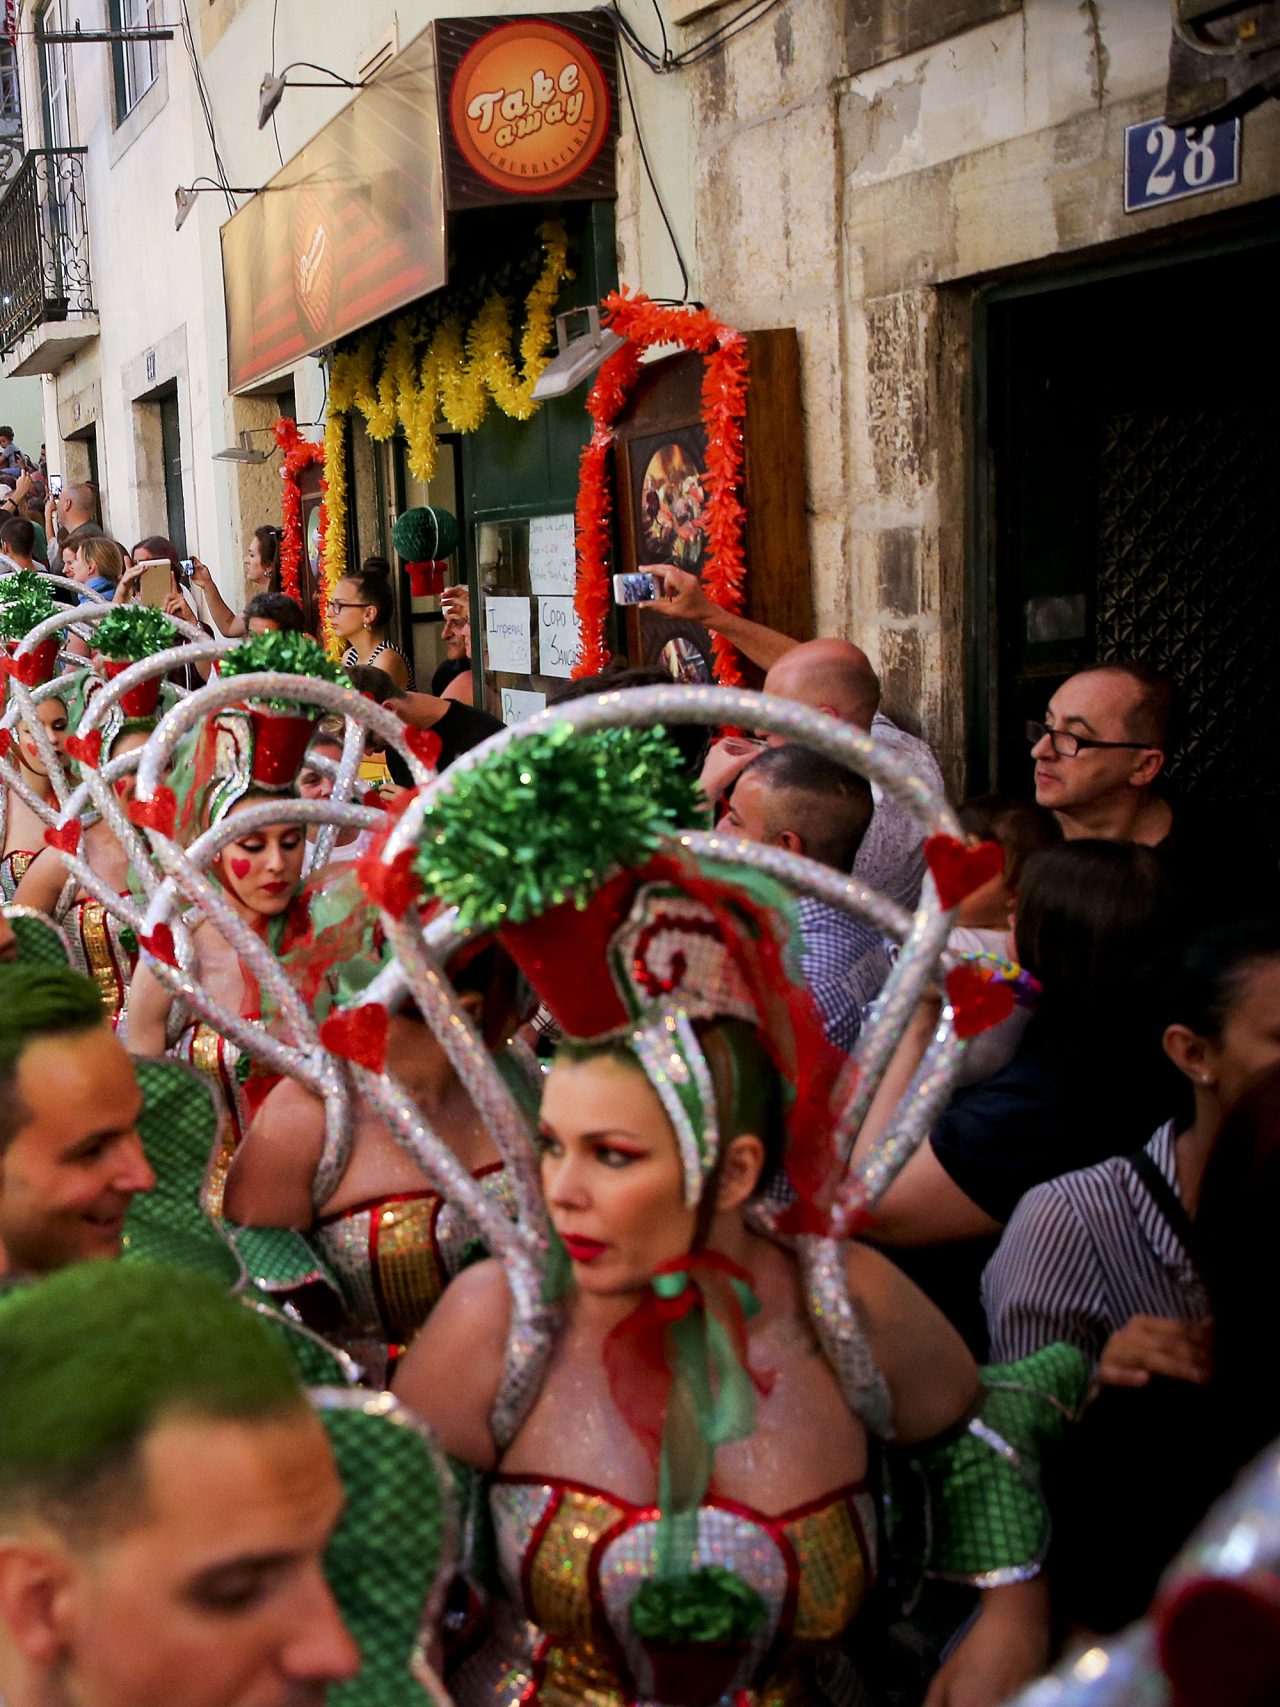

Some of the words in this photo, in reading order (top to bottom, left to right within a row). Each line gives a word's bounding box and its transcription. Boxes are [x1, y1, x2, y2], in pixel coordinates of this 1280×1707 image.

[467, 63, 579, 132] Take
[494, 91, 584, 148] away
[1146, 124, 1216, 197] 28
